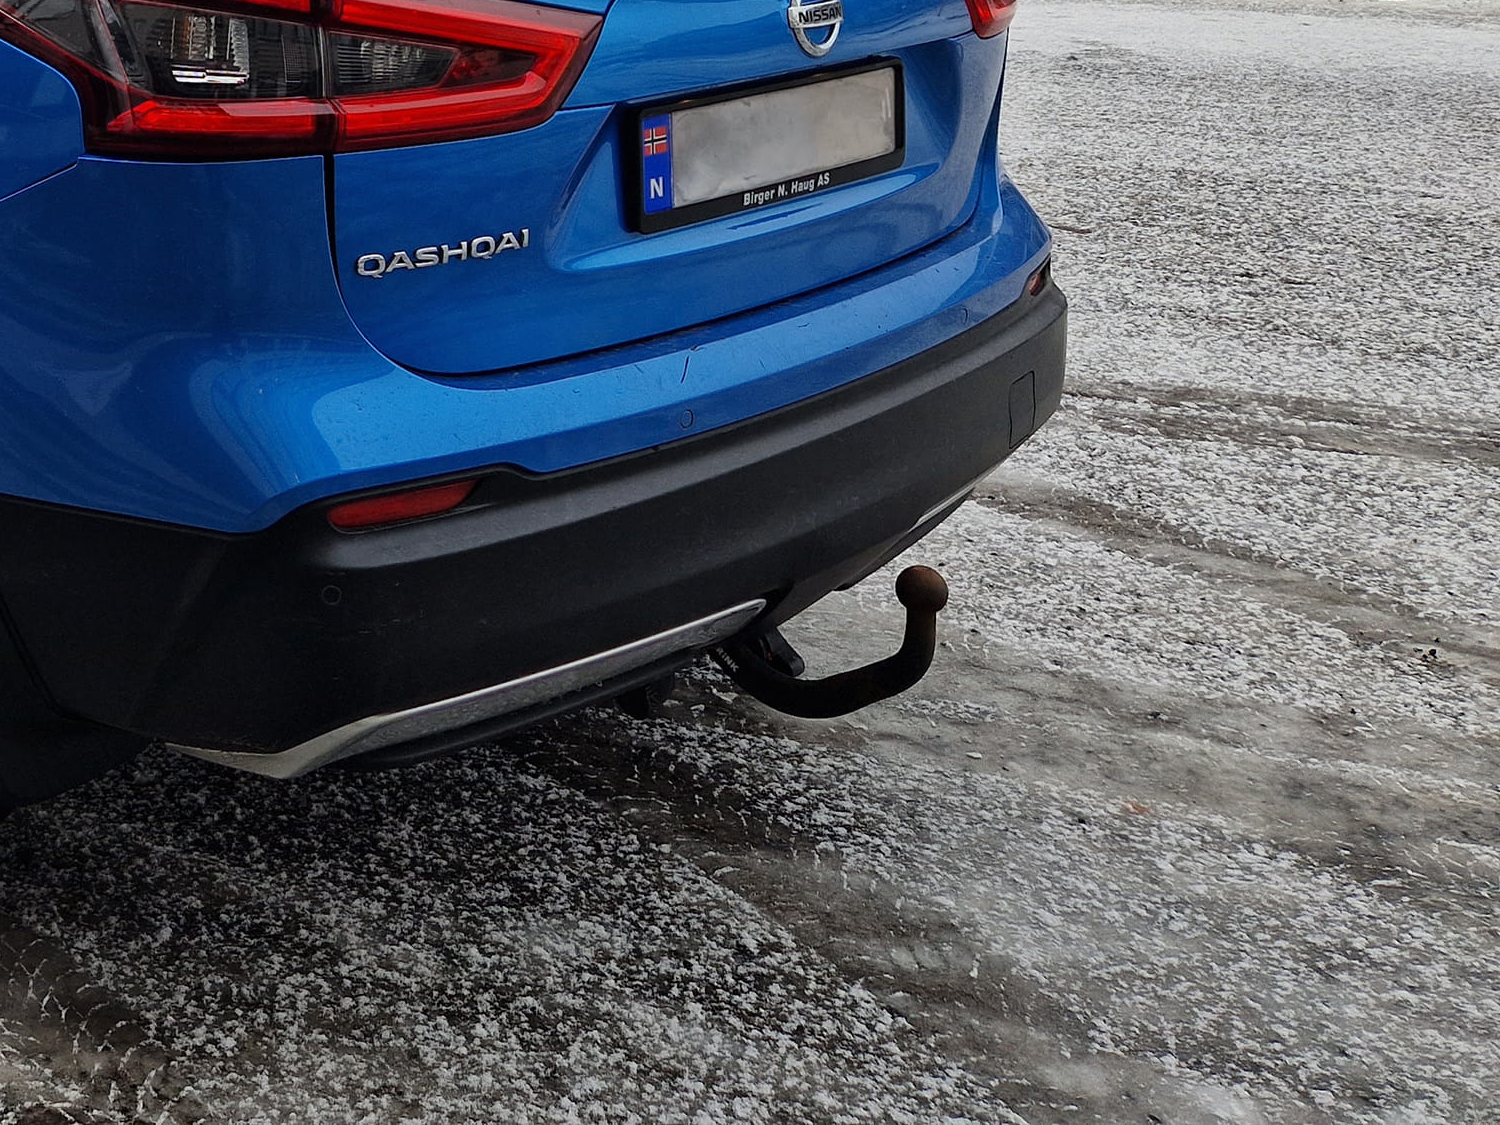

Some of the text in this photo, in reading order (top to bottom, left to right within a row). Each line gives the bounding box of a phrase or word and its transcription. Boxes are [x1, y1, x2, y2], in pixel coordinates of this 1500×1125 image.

[798, 5, 842, 24] NISSAN
[650, 176, 664, 199] N
[743, 172, 830, 206] Birger N. Haug AS
[357, 228, 530, 278] QASHQAI
